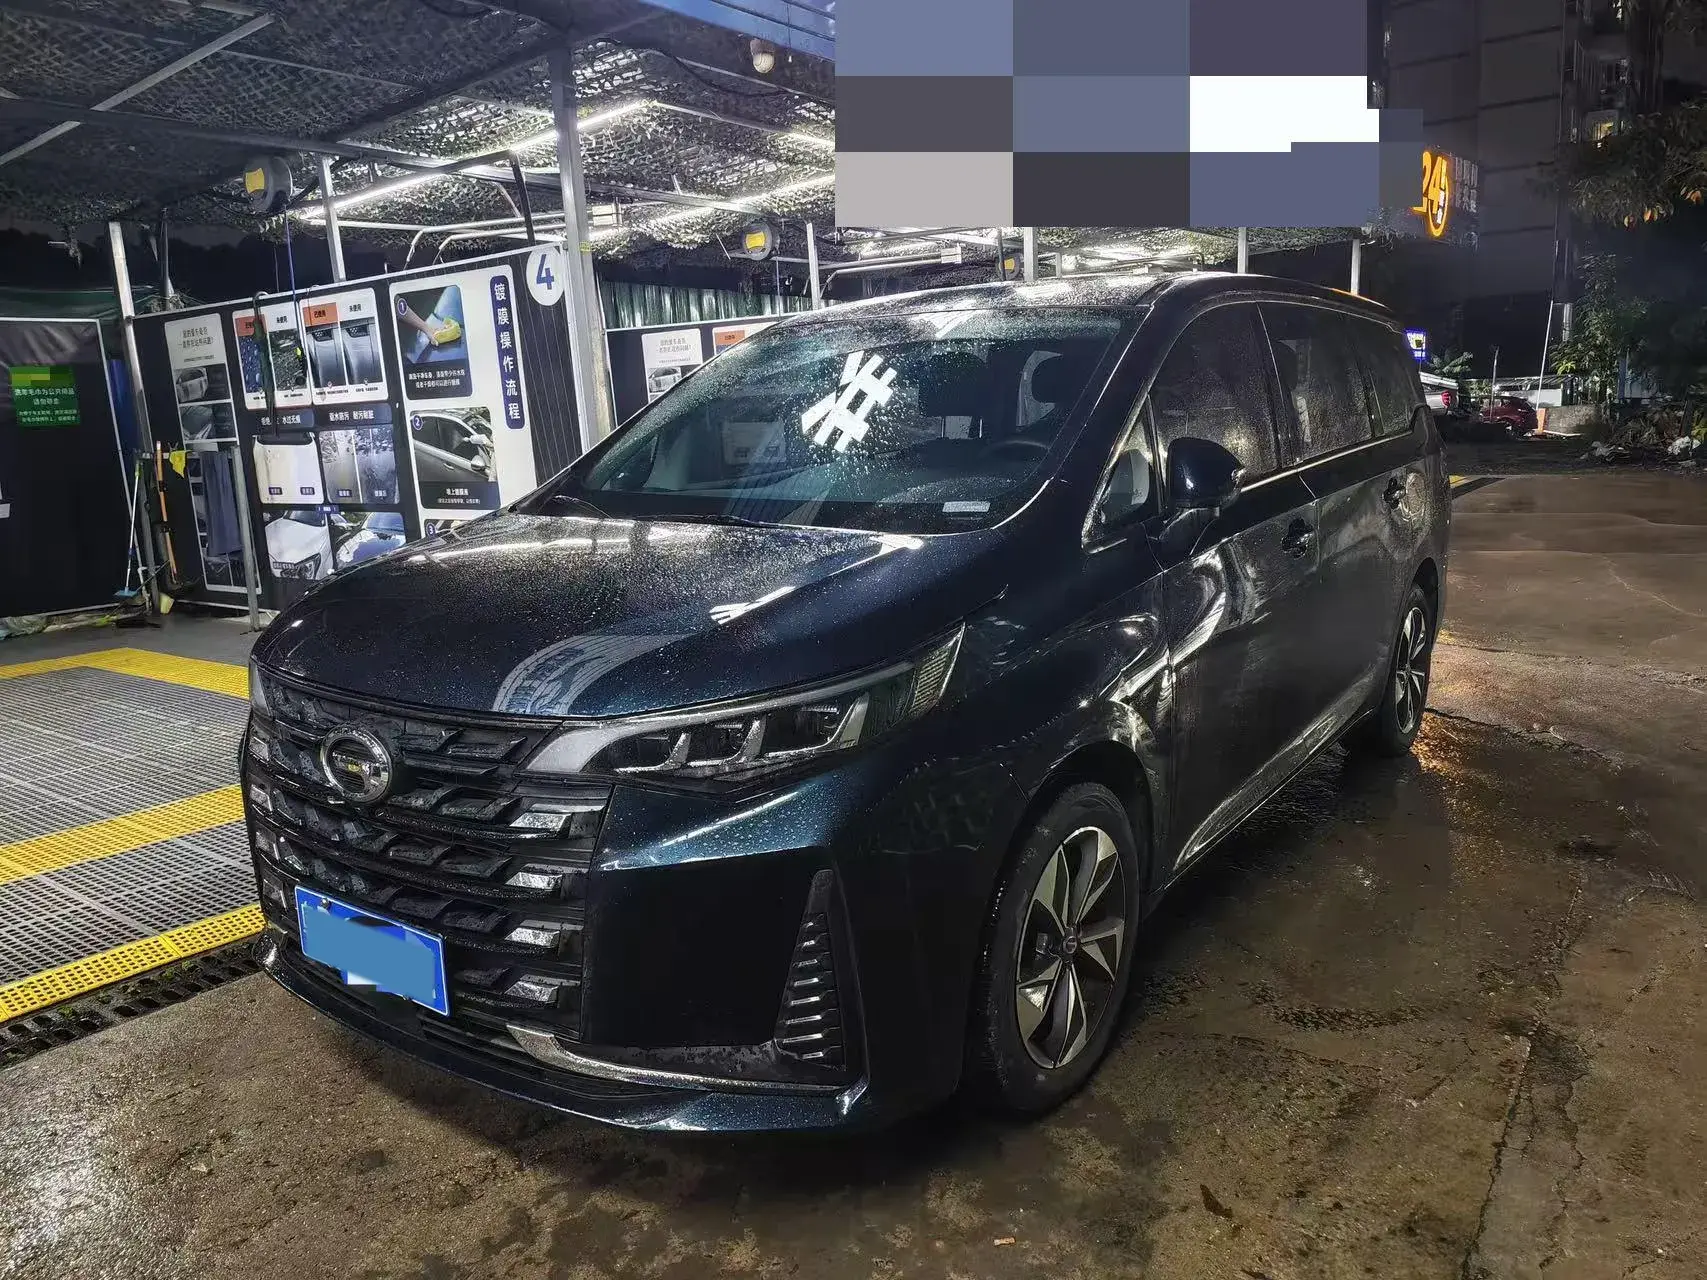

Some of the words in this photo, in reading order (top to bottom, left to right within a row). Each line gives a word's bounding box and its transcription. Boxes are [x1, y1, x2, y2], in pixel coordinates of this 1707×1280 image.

[536, 253, 555, 290] 4
[314, 310, 326, 318] 已使用
[349, 304, 361, 312] 未使用
[494, 283, 521, 419] 镀膜操作流程
